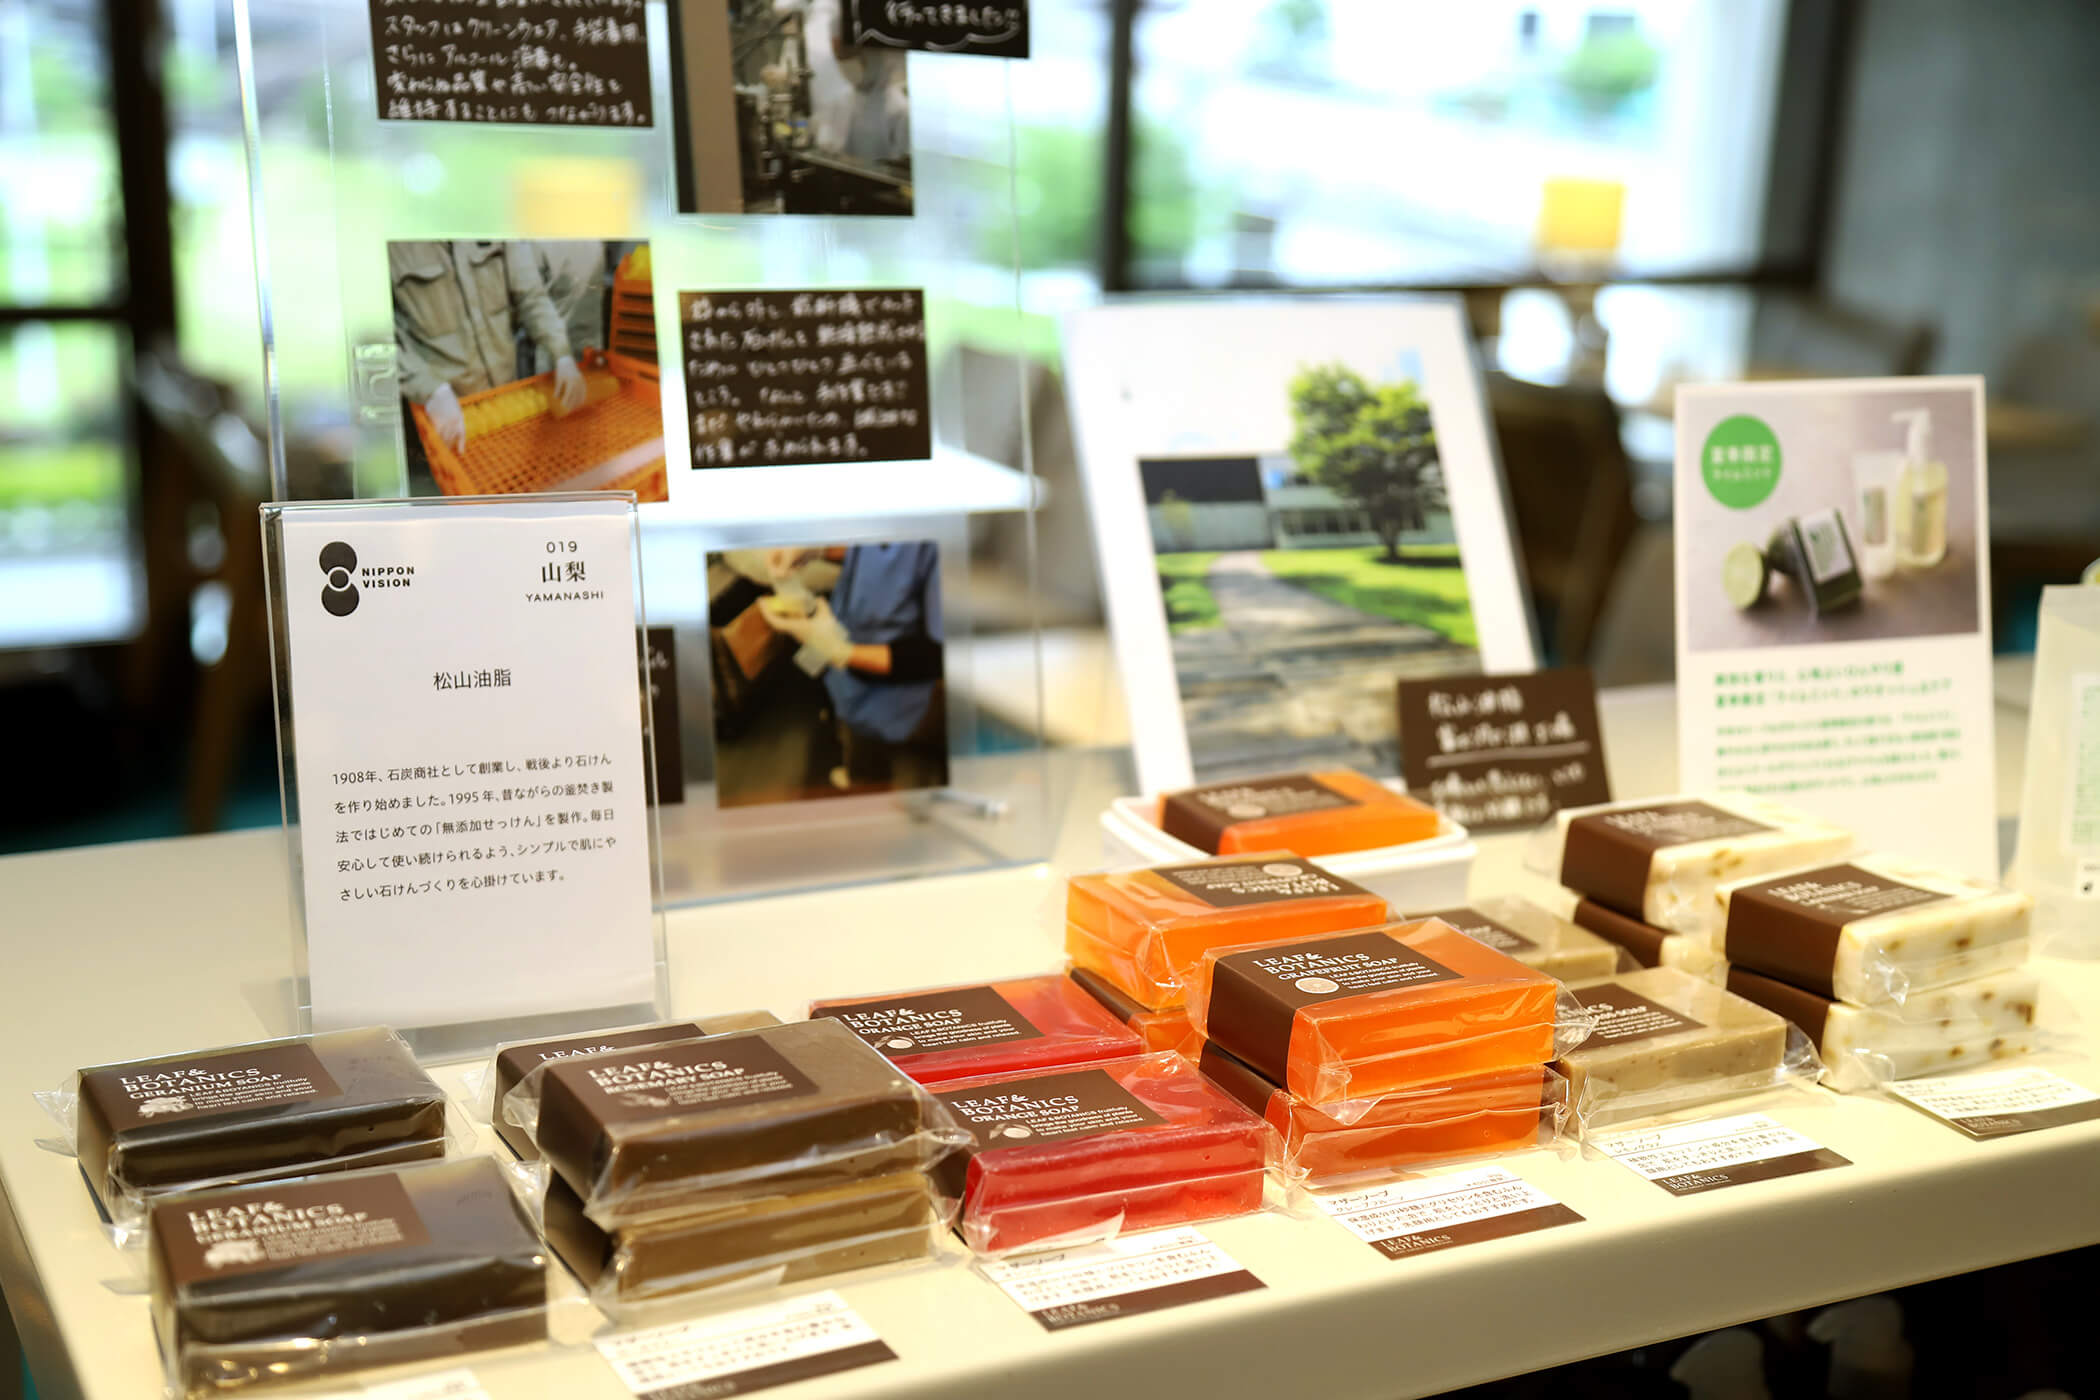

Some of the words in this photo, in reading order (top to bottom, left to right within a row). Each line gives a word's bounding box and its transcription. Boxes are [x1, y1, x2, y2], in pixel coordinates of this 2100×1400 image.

[546, 541, 578, 553] 019
[361, 566, 415, 577] NIPPON
[541, 561, 586, 583] 山梨
[362, 577, 411, 588] VISION
[525, 591, 604, 602] YAMANASHI
[433, 668, 512, 691] 松山油脂
[333, 753, 612, 785] 1908年、石炭商社として創業し、戦後より石けん
[336, 808, 615, 844] 法ではじめての「無添加せっけん」を製作。毎日
[337, 836, 617, 872] 安心して使い続けられるよう、シンプルで肌にや
[341, 868, 565, 901] さしい石けんづくりを心掛けています。
[1264, 953, 1370, 975] BOTANICS
[1278, 963, 1363, 981] GRAPEFRUIT
[1363, 957, 1399, 968] SOAP
[843, 1008, 915, 1022] LEAF&
[850, 1009, 962, 1029] BOTANICS
[859, 1023, 923, 1035] ORANGE
[925, 1018, 962, 1028] SOAP
[537, 1045, 617, 1060] LEAF&
[120, 1068, 208, 1085] LEAF&
[122, 1068, 261, 1093] BOTANICS
[596, 1061, 727, 1087] BOTANICS
[699, 1068, 745, 1081] SOAP
[129, 1081, 236, 1100] GERANIUM
[238, 1074, 282, 1084] SOAP
[951, 1094, 1028, 1108] LEAF&
[959, 1095, 1079, 1117] BOTANICS
[970, 1111, 1038, 1123] ORANGE
[1040, 1105, 1079, 1117] SOAP
[1669, 1174, 1729, 1189] BOTANICS
[192, 1204, 344, 1233] BOTANICS
[1387, 1235, 1451, 1252] BOTANICS
